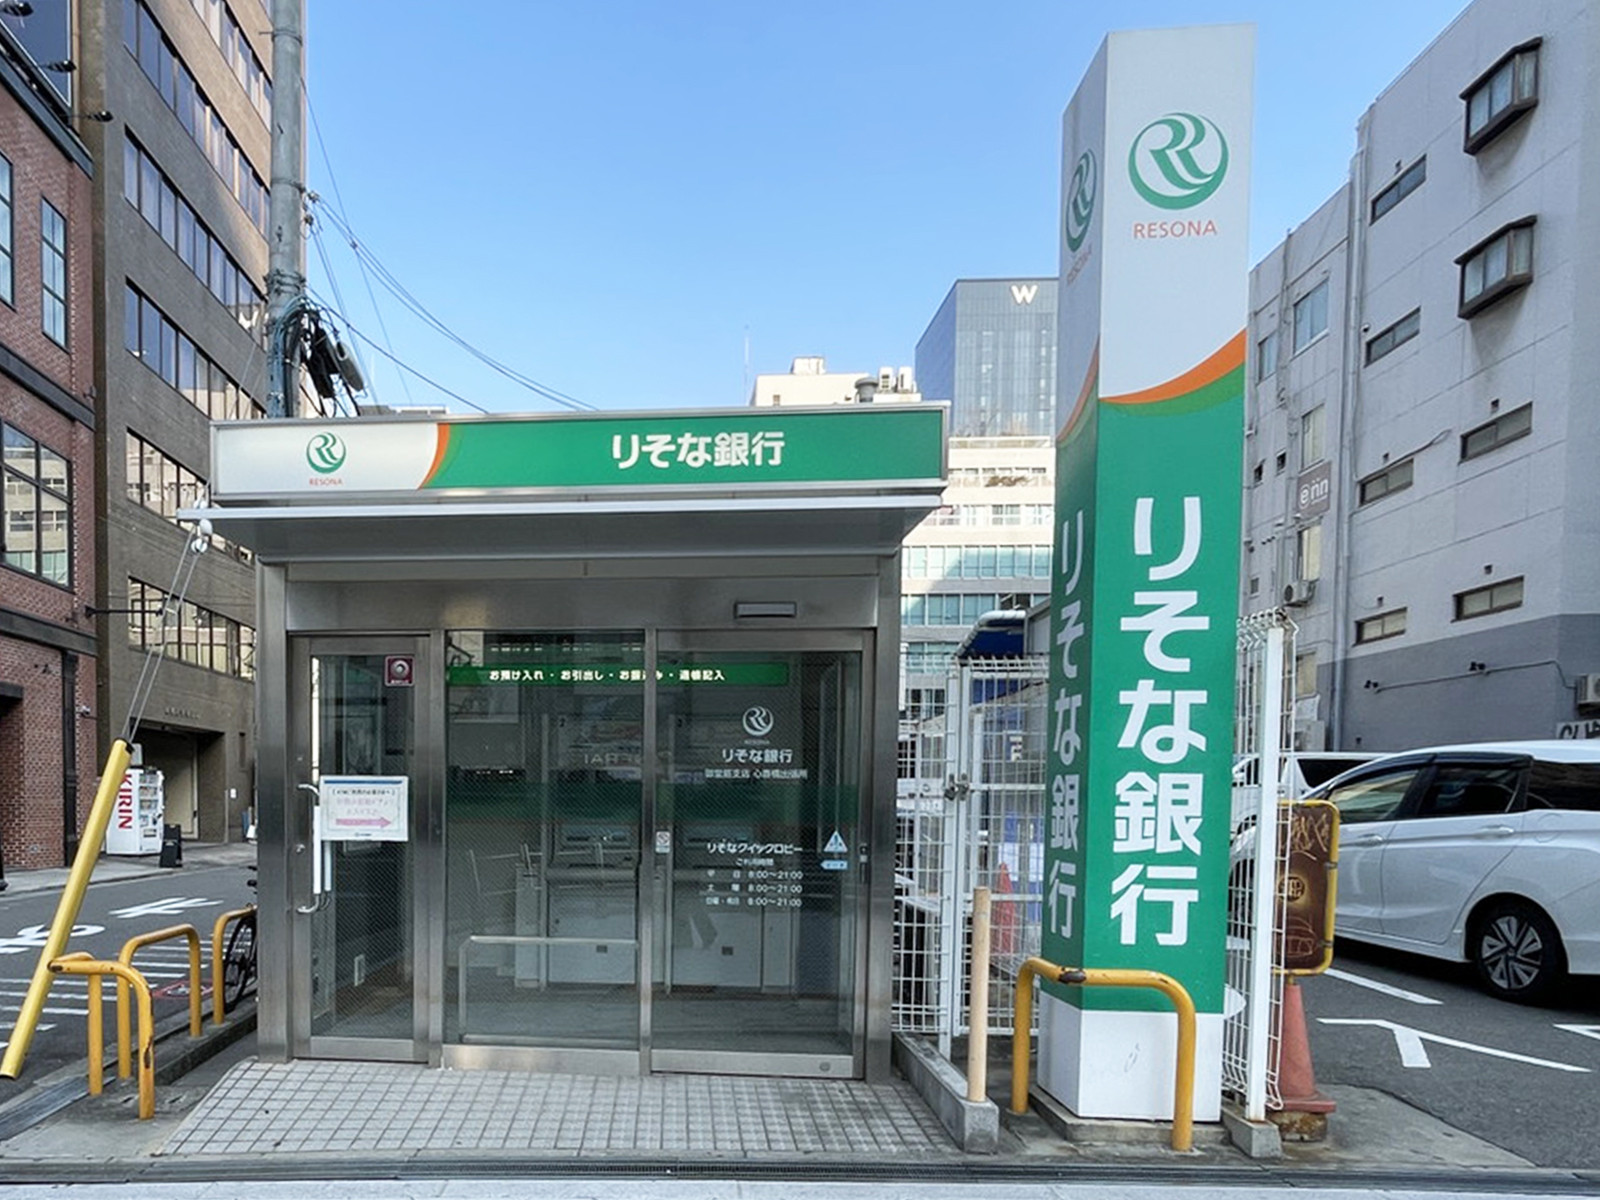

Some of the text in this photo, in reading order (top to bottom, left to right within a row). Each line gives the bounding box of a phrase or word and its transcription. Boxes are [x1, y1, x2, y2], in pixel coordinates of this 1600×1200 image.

[1133, 219, 1218, 239] RESONA
[1010, 284, 1038, 304] W
[612, 431, 785, 469] りそな銀行
[1048, 510, 1085, 939] りそな銀行
[1110, 496, 1210, 946] りそな銀行
[722, 749, 793, 763] りそな銀行
[117, 773, 133, 830] KIRIN
[707, 842, 803, 854] りそなクイックロビー
